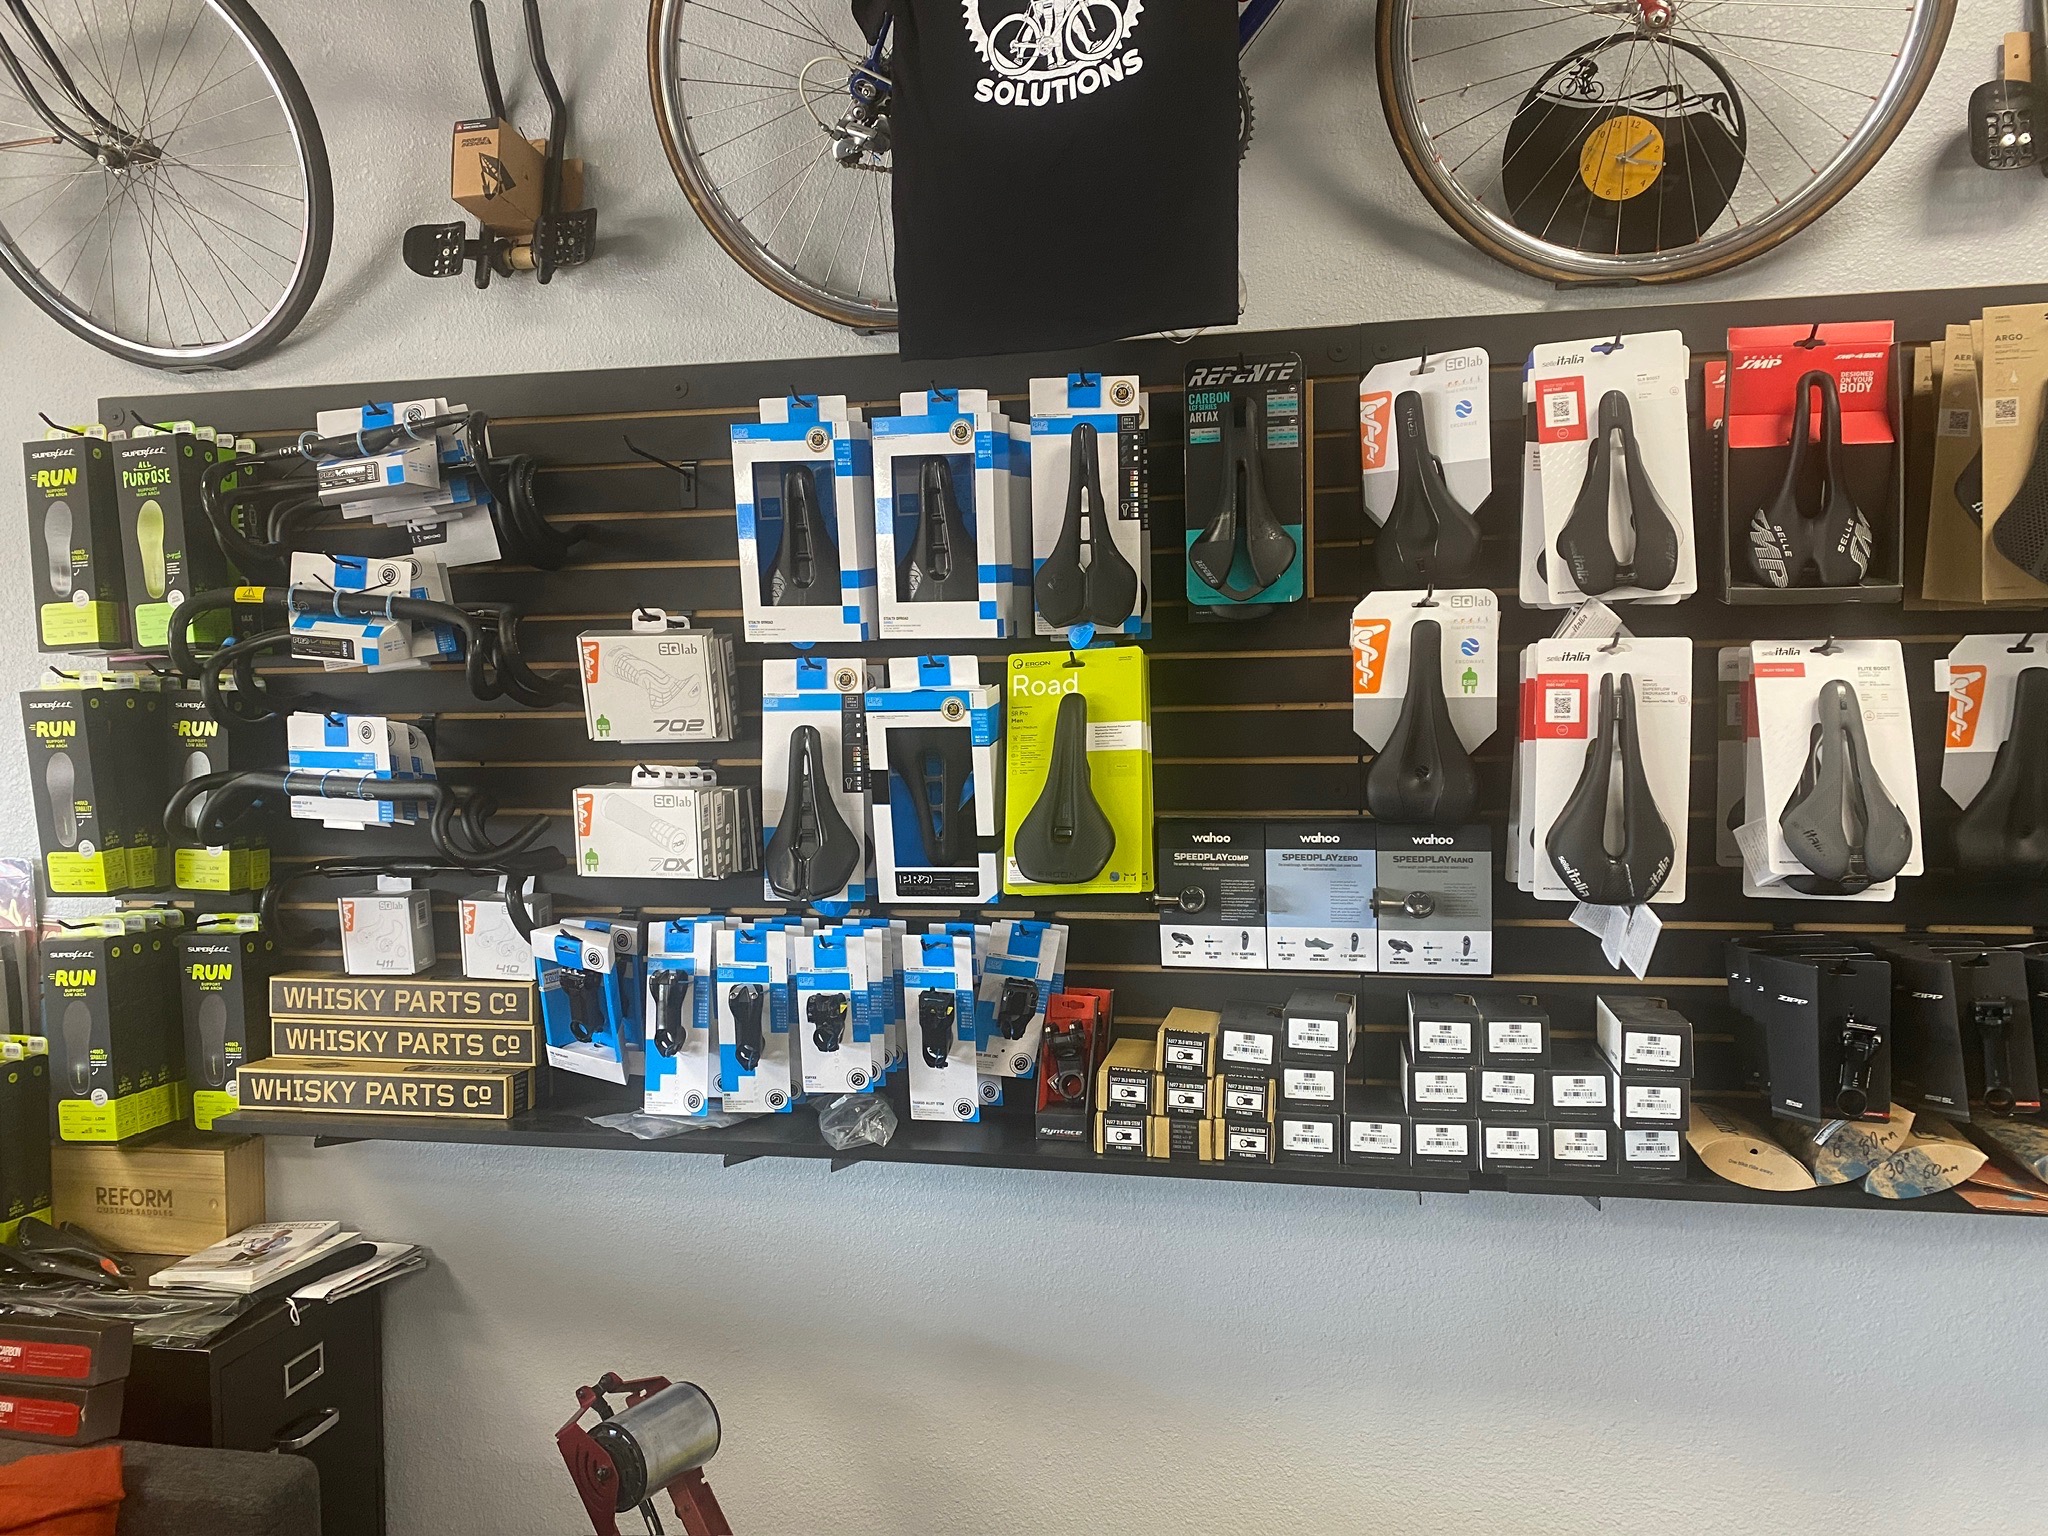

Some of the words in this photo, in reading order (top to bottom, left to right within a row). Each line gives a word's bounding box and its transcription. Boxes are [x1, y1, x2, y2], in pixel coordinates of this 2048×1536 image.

[974, 48, 1144, 107] SOLUTIONS
[1995, 333, 2023, 342] ARGO
[1736, 359, 1782, 370] SMP
[1188, 361, 1298, 387] REPENTE
[1840, 383, 1873, 394] BODY
[1188, 391, 1230, 405] CARBON
[1189, 411, 1218, 423] ARTAX
[138, 461, 151, 469] ALL
[37, 468, 77, 488] RUN
[122, 467, 171, 488] PURPOSE
[1773, 525, 1793, 558] SELLE
[1837, 518, 1855, 553] SELLE
[1013, 672, 1079, 697] Road
[36, 720, 76, 737] RUN
[178, 720, 218, 737] RUN
[653, 718, 704, 733] 702
[1192, 832, 1231, 843] wahoo
[1300, 832, 1340, 843] wahoo
[1412, 834, 1454, 845] wahoo
[376, 960, 394, 968] 411
[496, 965, 519, 973] 410
[55, 970, 96, 986] RUN
[192, 964, 232, 980] RUN
[284, 986, 386, 1011] WHISKY
[394, 990, 481, 1014] PARTS
[1778, 994, 1808, 1005] ZIPP
[1912, 991, 1943, 1000] ZIPP
[286, 1028, 388, 1053] WHISKY
[398, 1031, 484, 1055] PARTS
[251, 1078, 356, 1104] WHISKY
[365, 1082, 454, 1107] PARTS
[1040, 1127, 1083, 1137] Syntace
[96, 1187, 173, 1208] REFORM
[97, 1207, 133, 1215] CUSTOM
[136, 1208, 173, 1216] SADDLES
